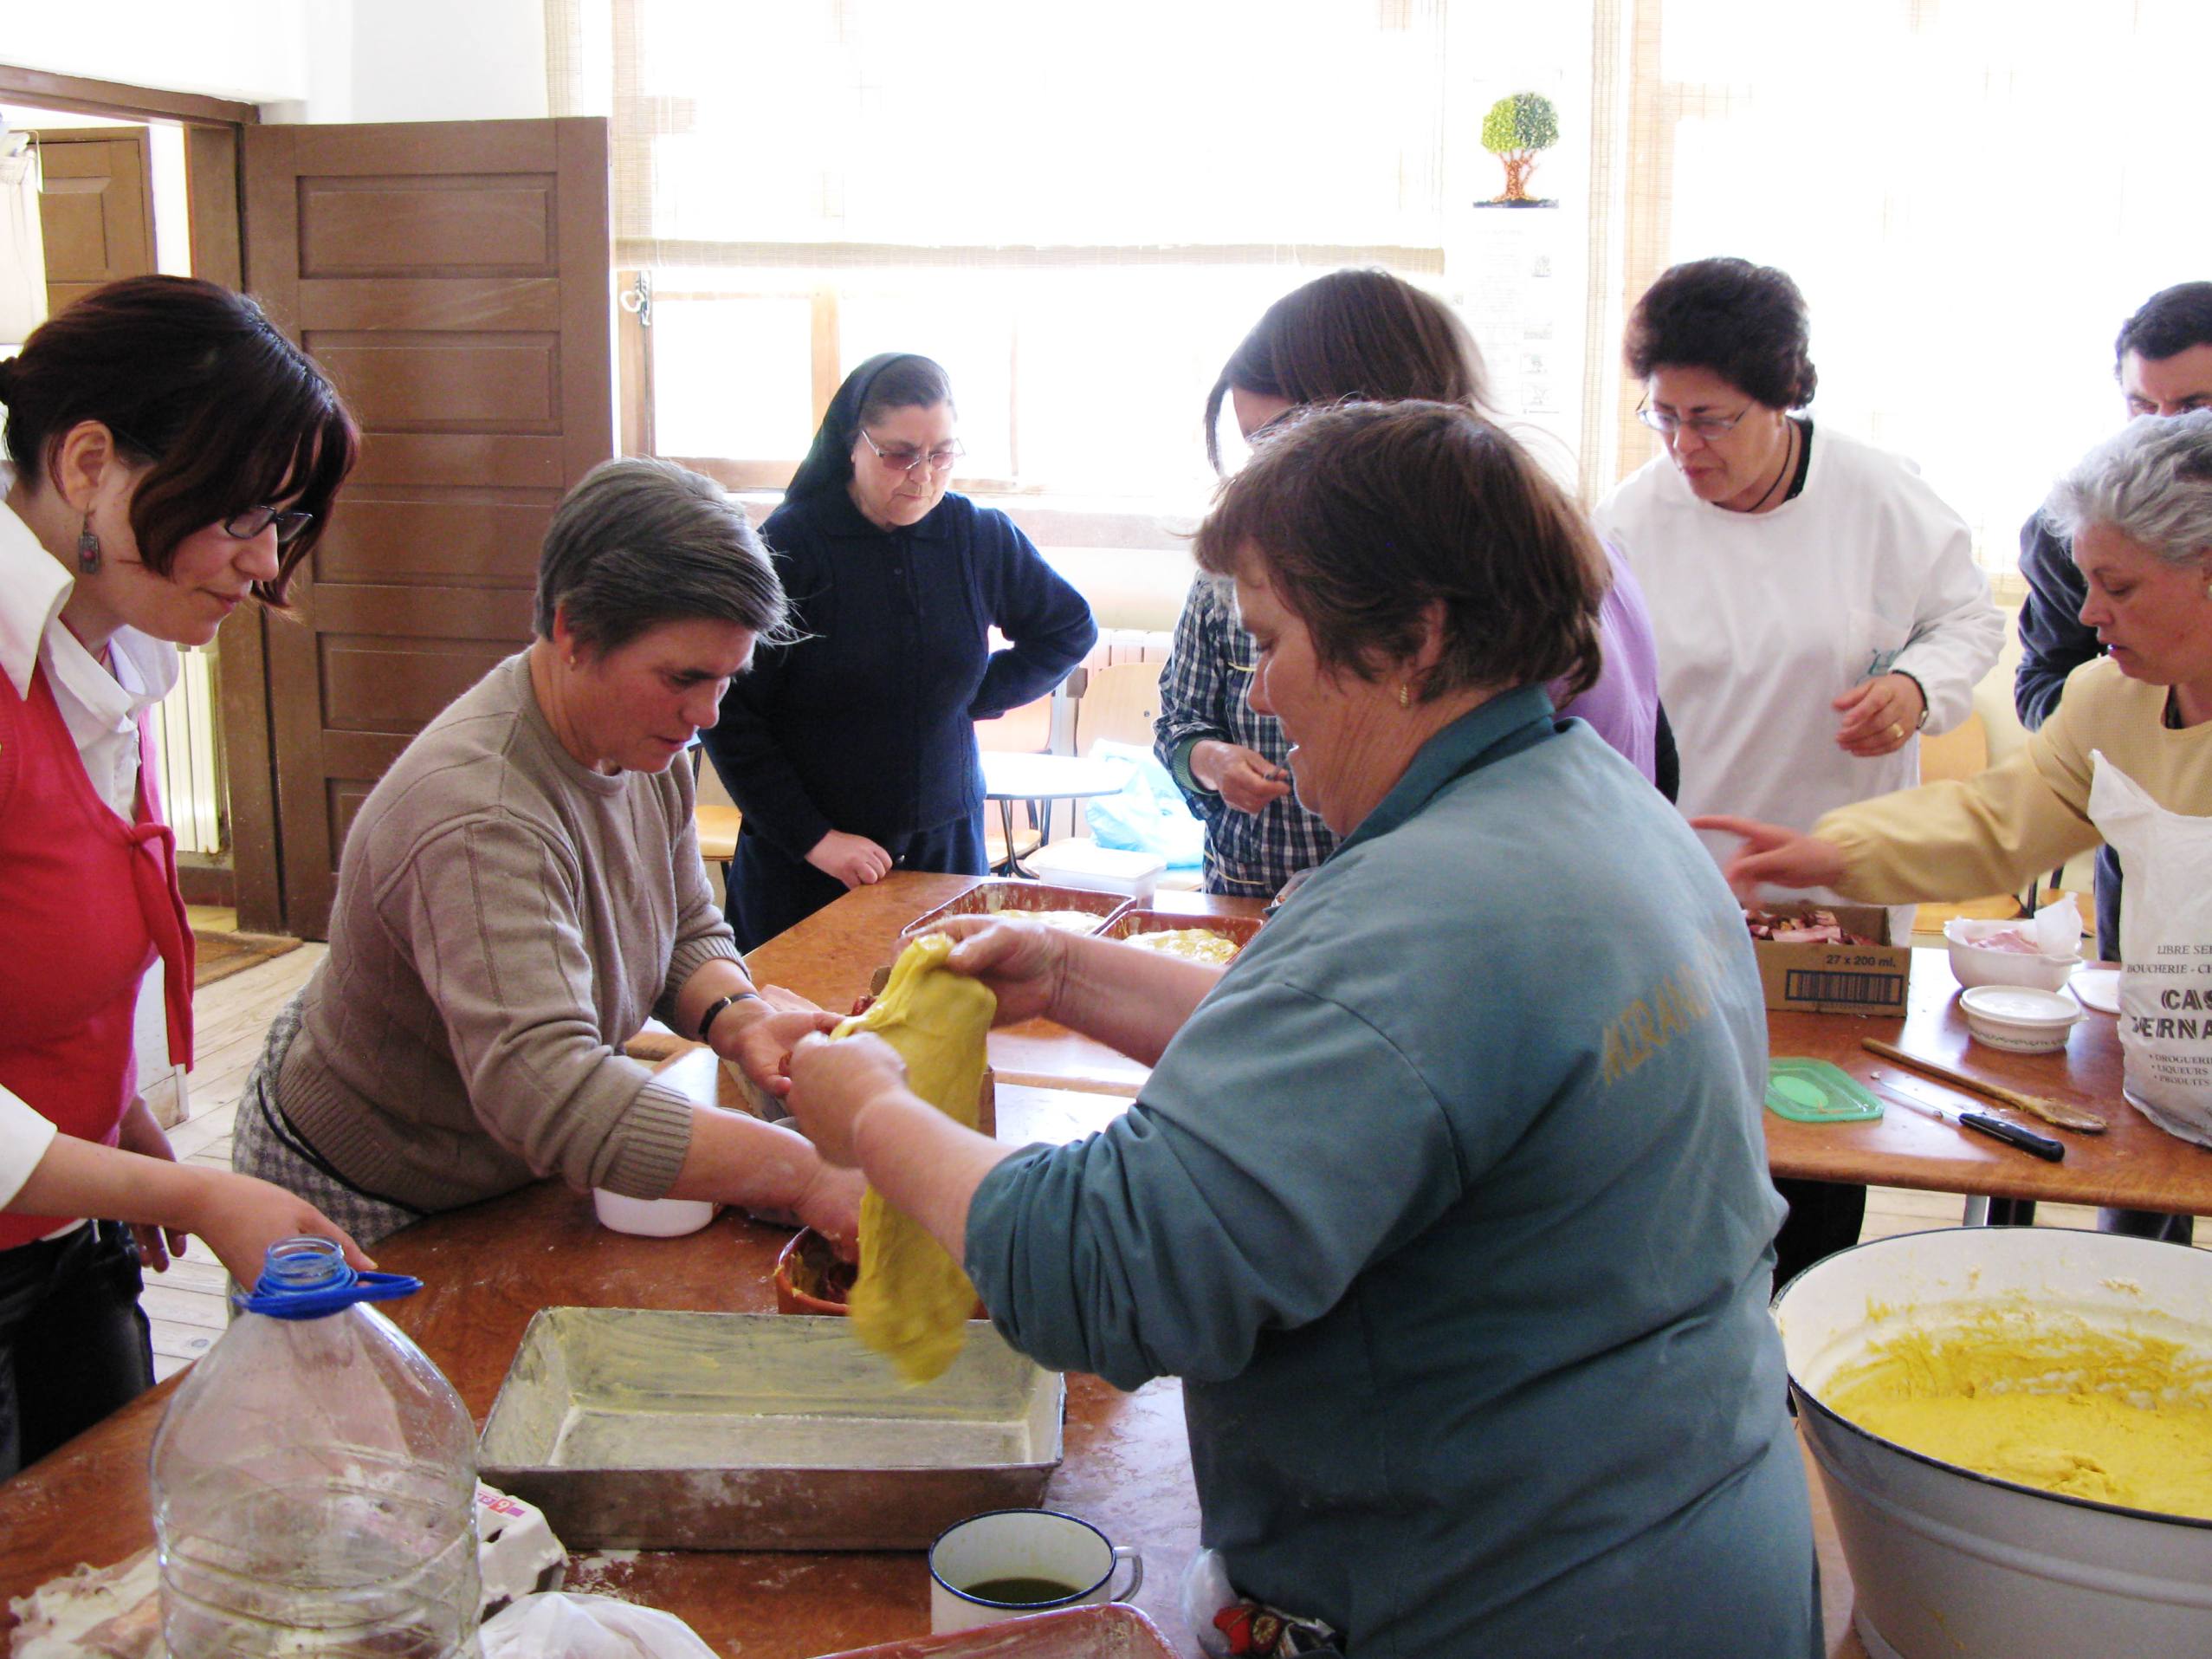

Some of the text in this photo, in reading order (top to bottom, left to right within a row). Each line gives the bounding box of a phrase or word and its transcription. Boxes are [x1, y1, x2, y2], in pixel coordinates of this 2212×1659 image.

[2157, 945, 2189, 955] LIBRE
[1826, 955, 1897, 968] 27 x 200 ml.
[2127, 964, 2188, 974] BOUCHERIE
[2157, 1064, 2209, 1076] LIQUEURS
[2159, 1074, 2210, 1086] PRODUITS
